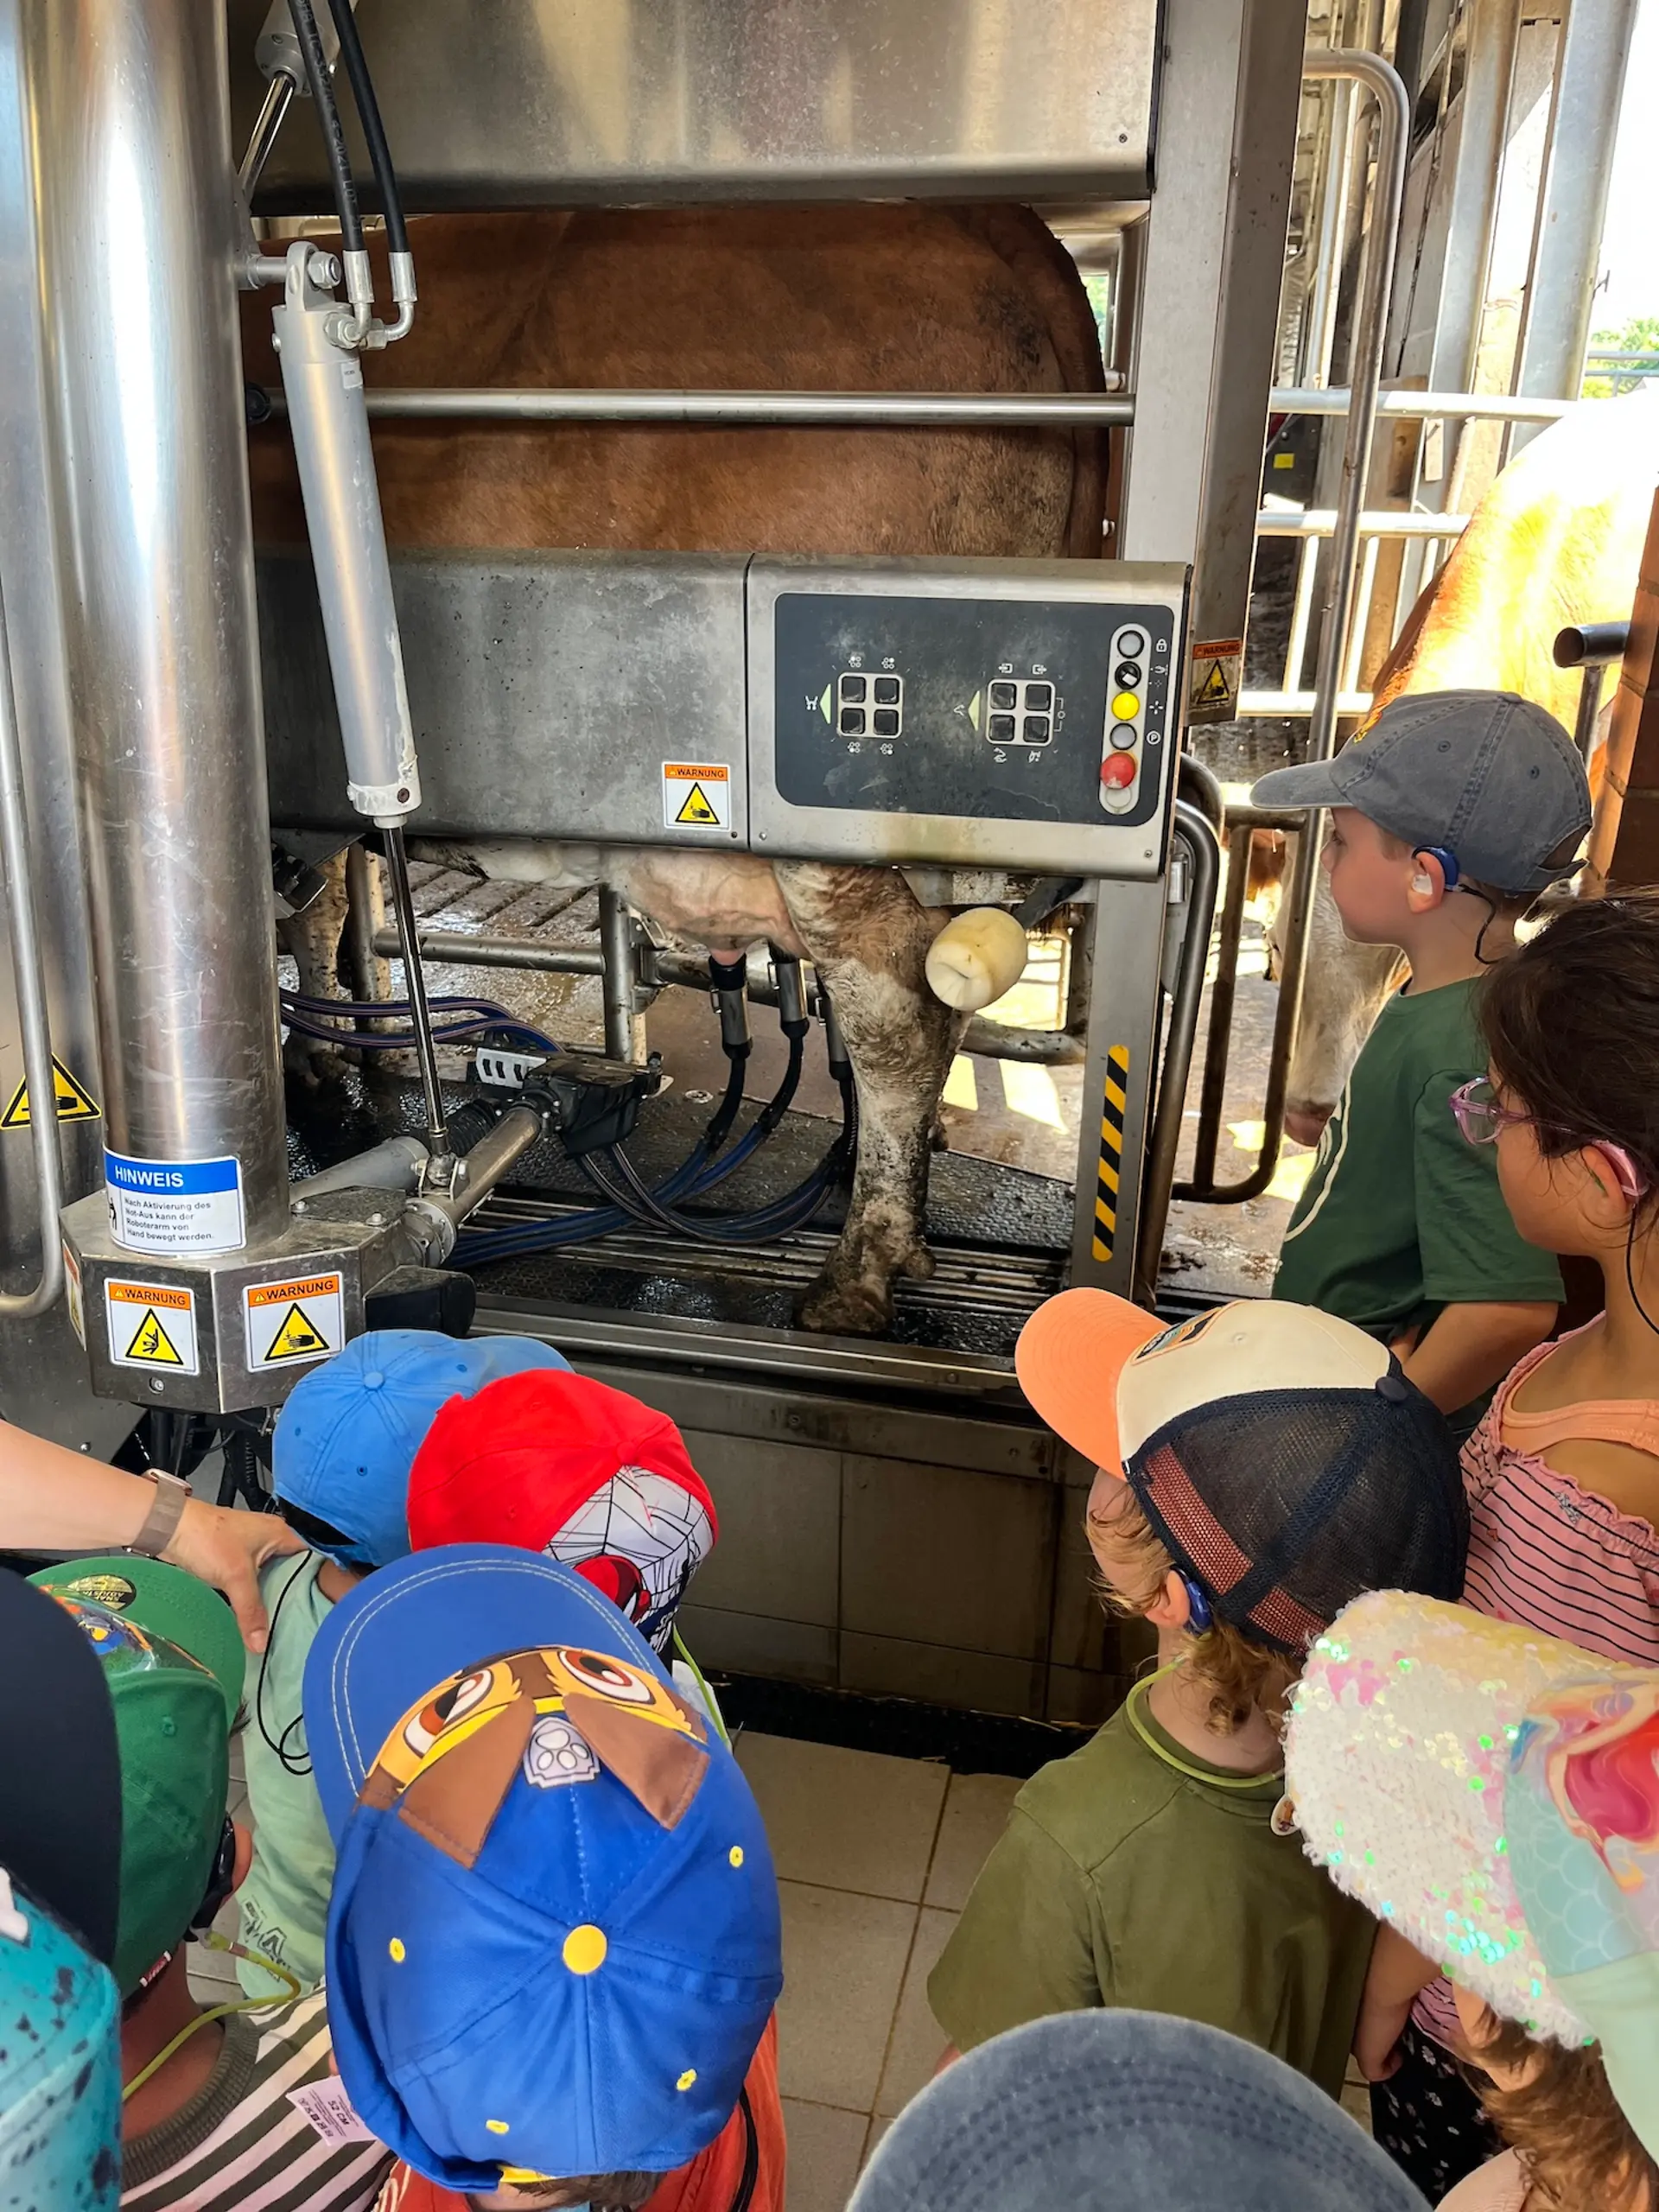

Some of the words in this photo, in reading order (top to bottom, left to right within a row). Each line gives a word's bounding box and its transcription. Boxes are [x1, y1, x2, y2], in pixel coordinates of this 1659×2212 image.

[677, 768, 724, 779] WARNUNG
[114, 1165, 184, 1187] HINWEIS
[124, 1198, 142, 1207] Nach
[143, 1200, 192, 1211] Aktivierung
[125, 1208, 154, 1219] Not-Aus
[156, 1211, 176, 1220] kann
[126, 1217, 170, 1230] Roboterarm
[127, 1229, 145, 1239] Hand
[146, 1232, 176, 1243] bewegt
[124, 1289, 186, 1306] WARNUNG
[266, 1281, 334, 1300] WARNUNG
[328, 2101, 340, 2110] 52
[336, 2113, 350, 2125] CM
